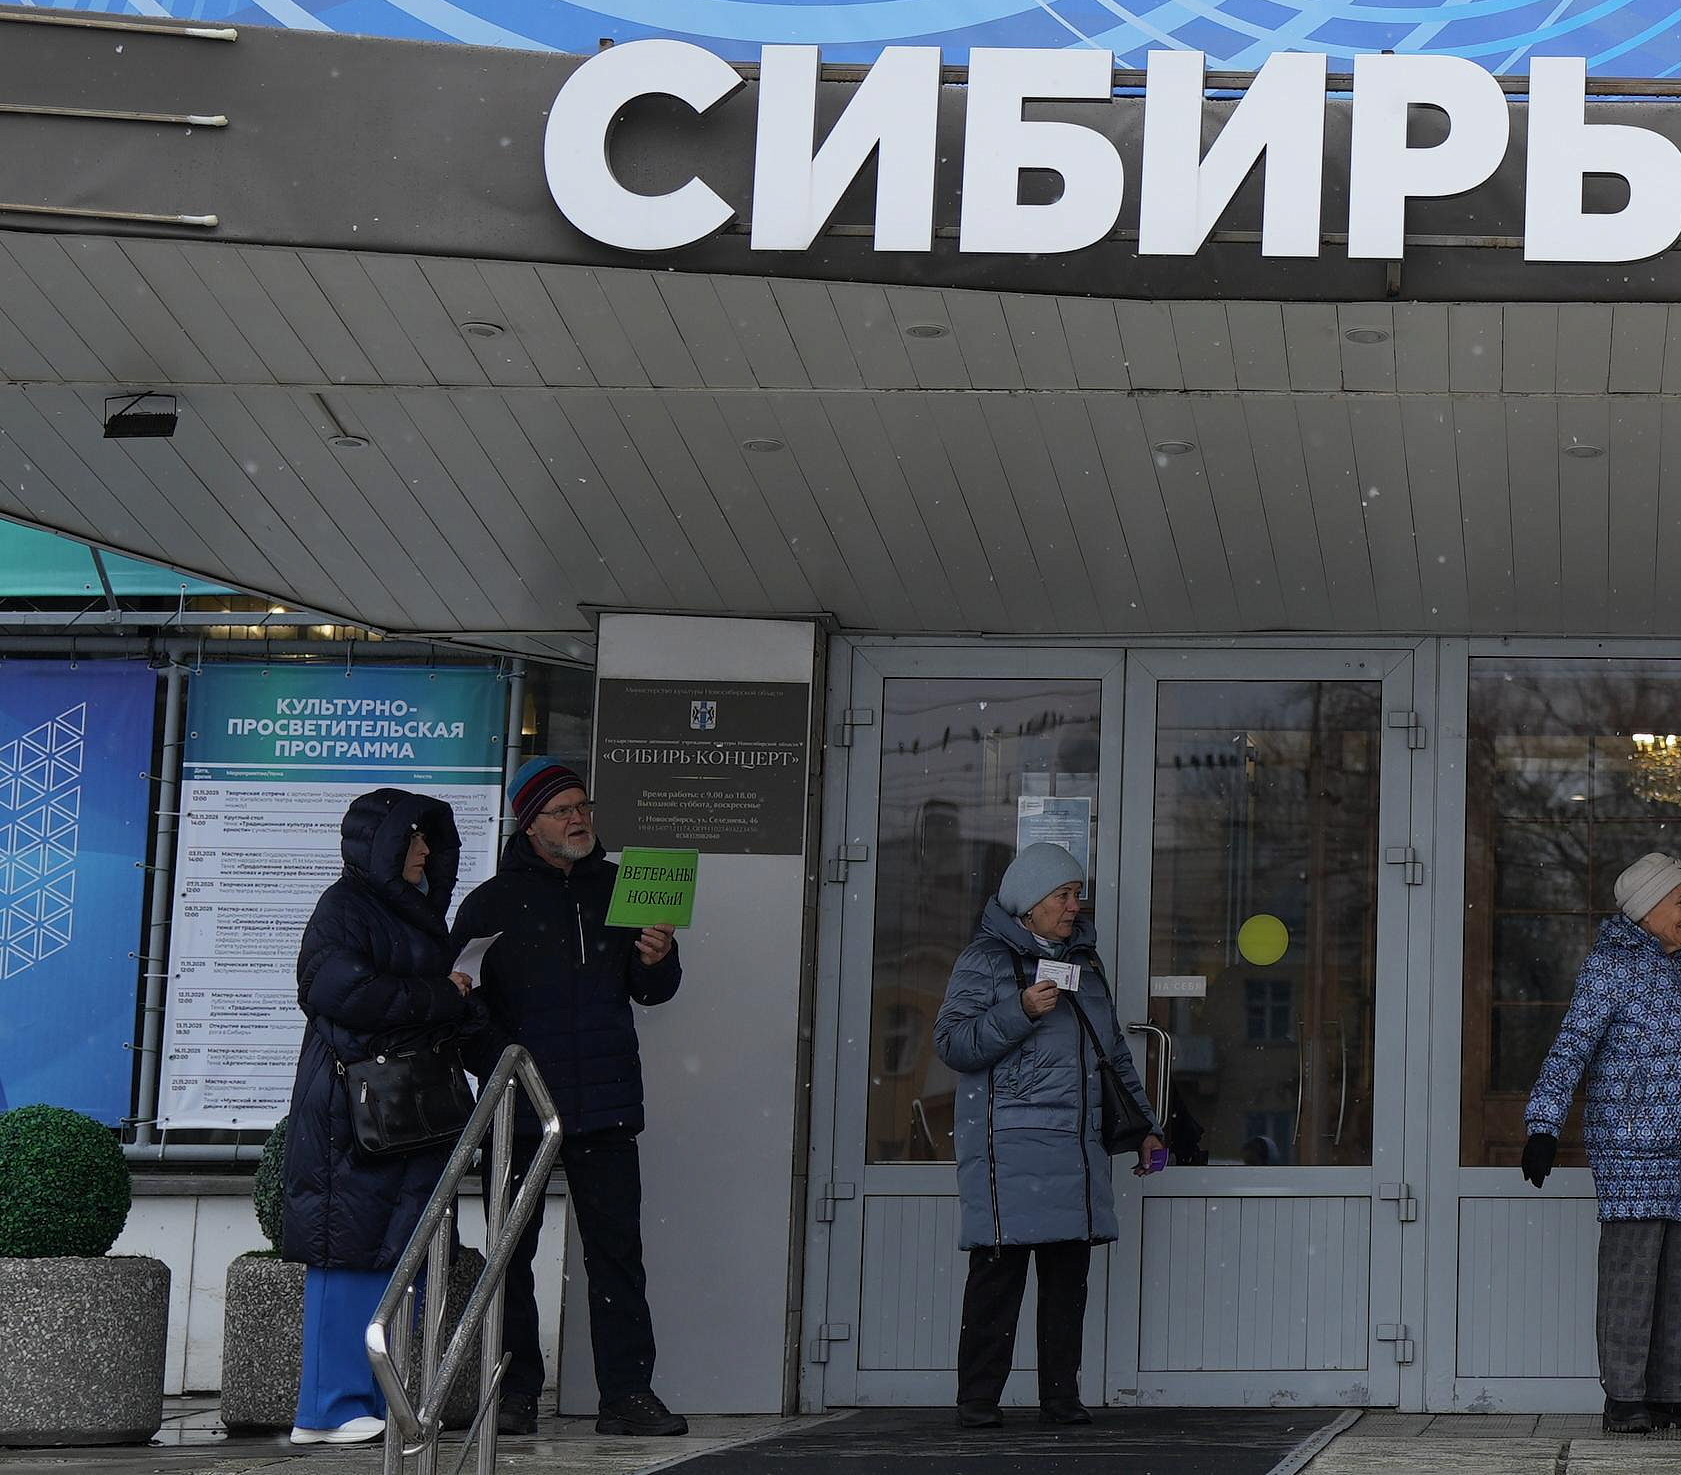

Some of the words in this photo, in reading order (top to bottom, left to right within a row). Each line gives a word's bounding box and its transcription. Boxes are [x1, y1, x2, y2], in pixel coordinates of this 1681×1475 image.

[276, 698, 417, 716] КУЛЬТУРНО-
[227, 718, 465, 739] ПРОСВЕТИТЕЛЬСКАЯ
[274, 740, 415, 758] ПРОГРАММА
[602, 748, 800, 769] «СИБИРЬ-КОНЦЕРТ»
[642, 790, 668, 799] Время
[668, 792, 699, 800] работы:
[706, 791, 723, 799] 9.00
[736, 792, 757, 800] 18.00
[637, 799, 678, 808] Выходной:
[679, 801, 712, 810] суббота,
[713, 802, 761, 810] воскресенье
[623, 866, 694, 882] ВЕТЕРАНЫ
[627, 890, 683, 906] НОККиИ
